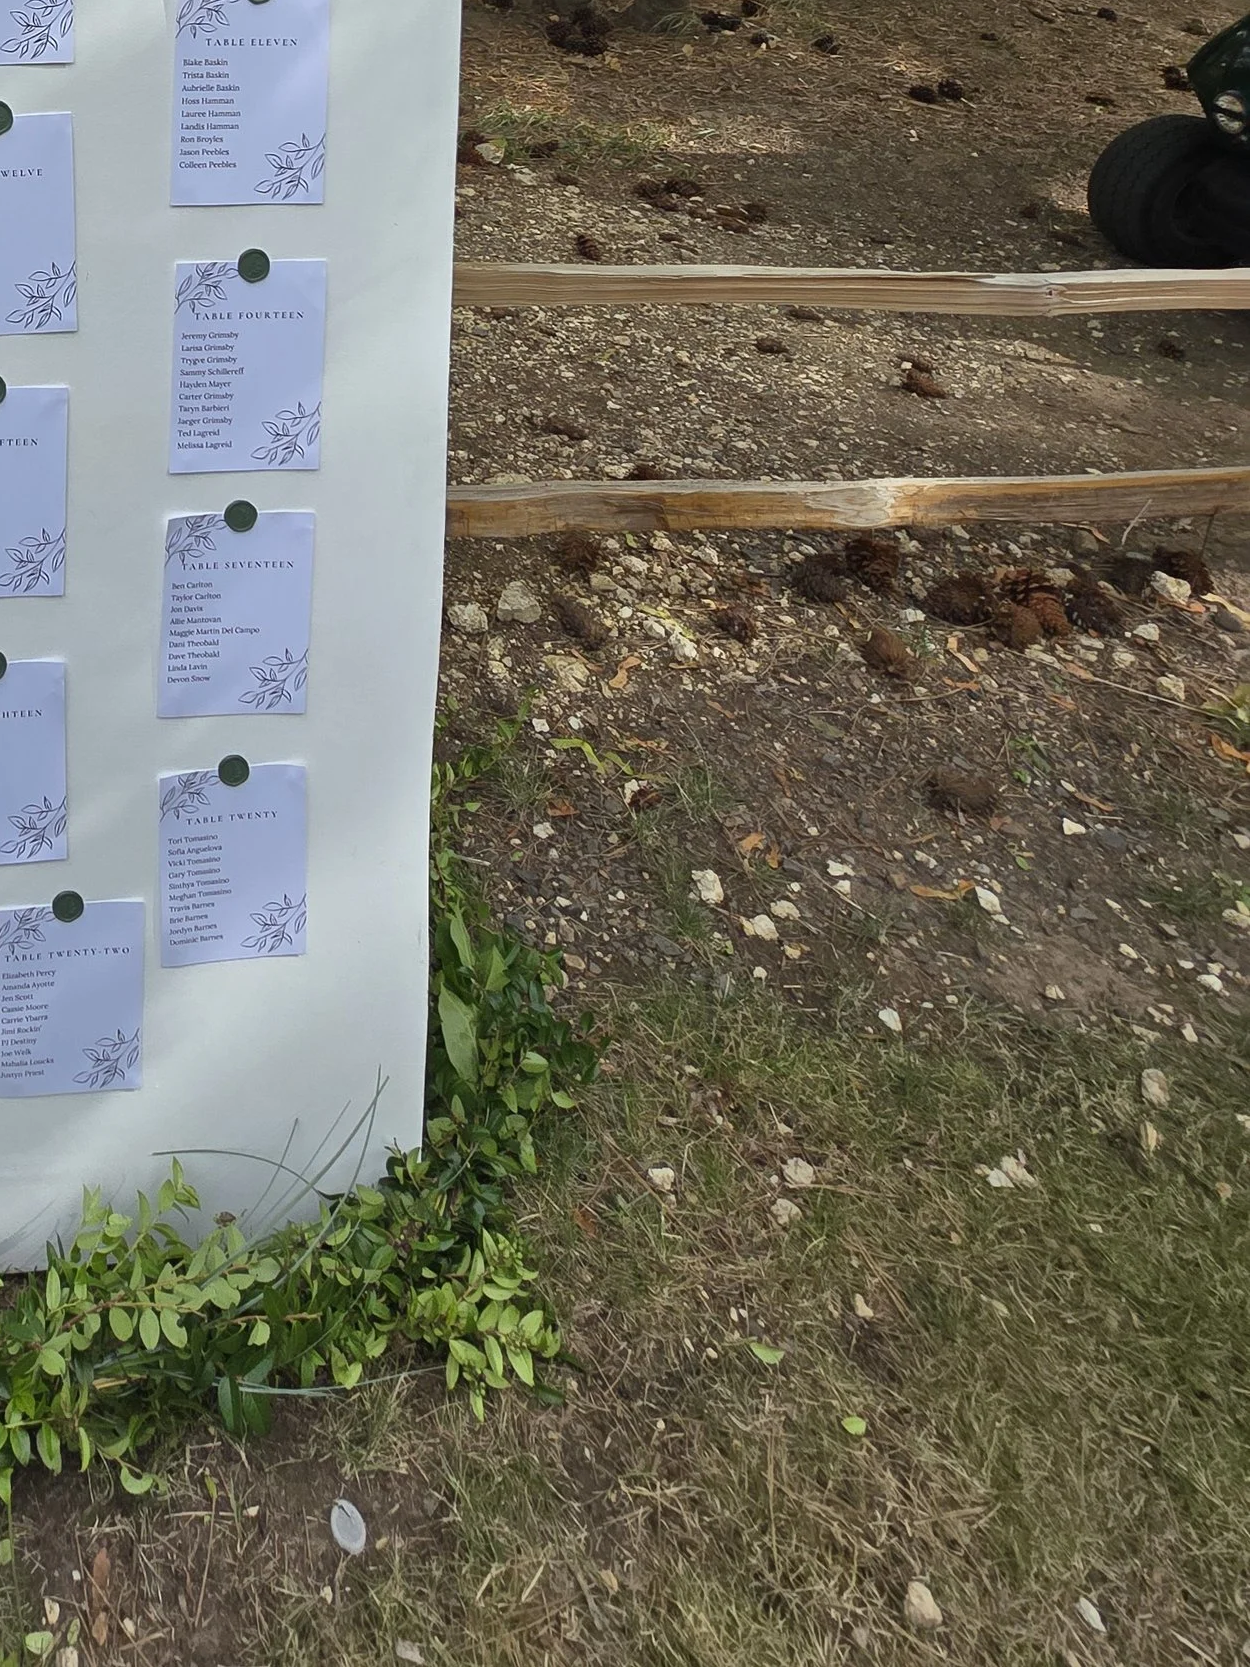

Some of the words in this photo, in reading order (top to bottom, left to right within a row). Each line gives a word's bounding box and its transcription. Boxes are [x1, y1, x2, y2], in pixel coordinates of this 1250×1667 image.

[205, 38, 245, 47] TABLE
[251, 38, 297, 47] ELEVEN
[181, 71, 204, 79] Trista
[205, 71, 230, 79] Baskin
[179, 148, 200, 156] Jason
[201, 147, 230, 156] Peebles
[193, 311, 232, 321] TABLE
[238, 311, 304, 320] FOURTEEN
[178, 393, 203, 401] Carter
[203, 391, 235, 401] Grimsby
[177, 441, 204, 450] Melissa
[205, 440, 232, 450] Lagreid
[224, 561, 294, 570] SEVENTEEN
[171, 582, 186, 590] Ben
[186, 581, 213, 589] Carlton
[167, 664, 188, 672] Linda
[188, 663, 208, 671] Lavin
[185, 815, 223, 826] TABLE
[229, 810, 278, 821] TWENTY
[168, 904, 191, 913] Travis
[191, 902, 215, 910] Barnes
[4, 952, 41, 963] TABLE
[2, 970, 35, 980] Elizabeth
[1, 982, 31, 991] Amanda
